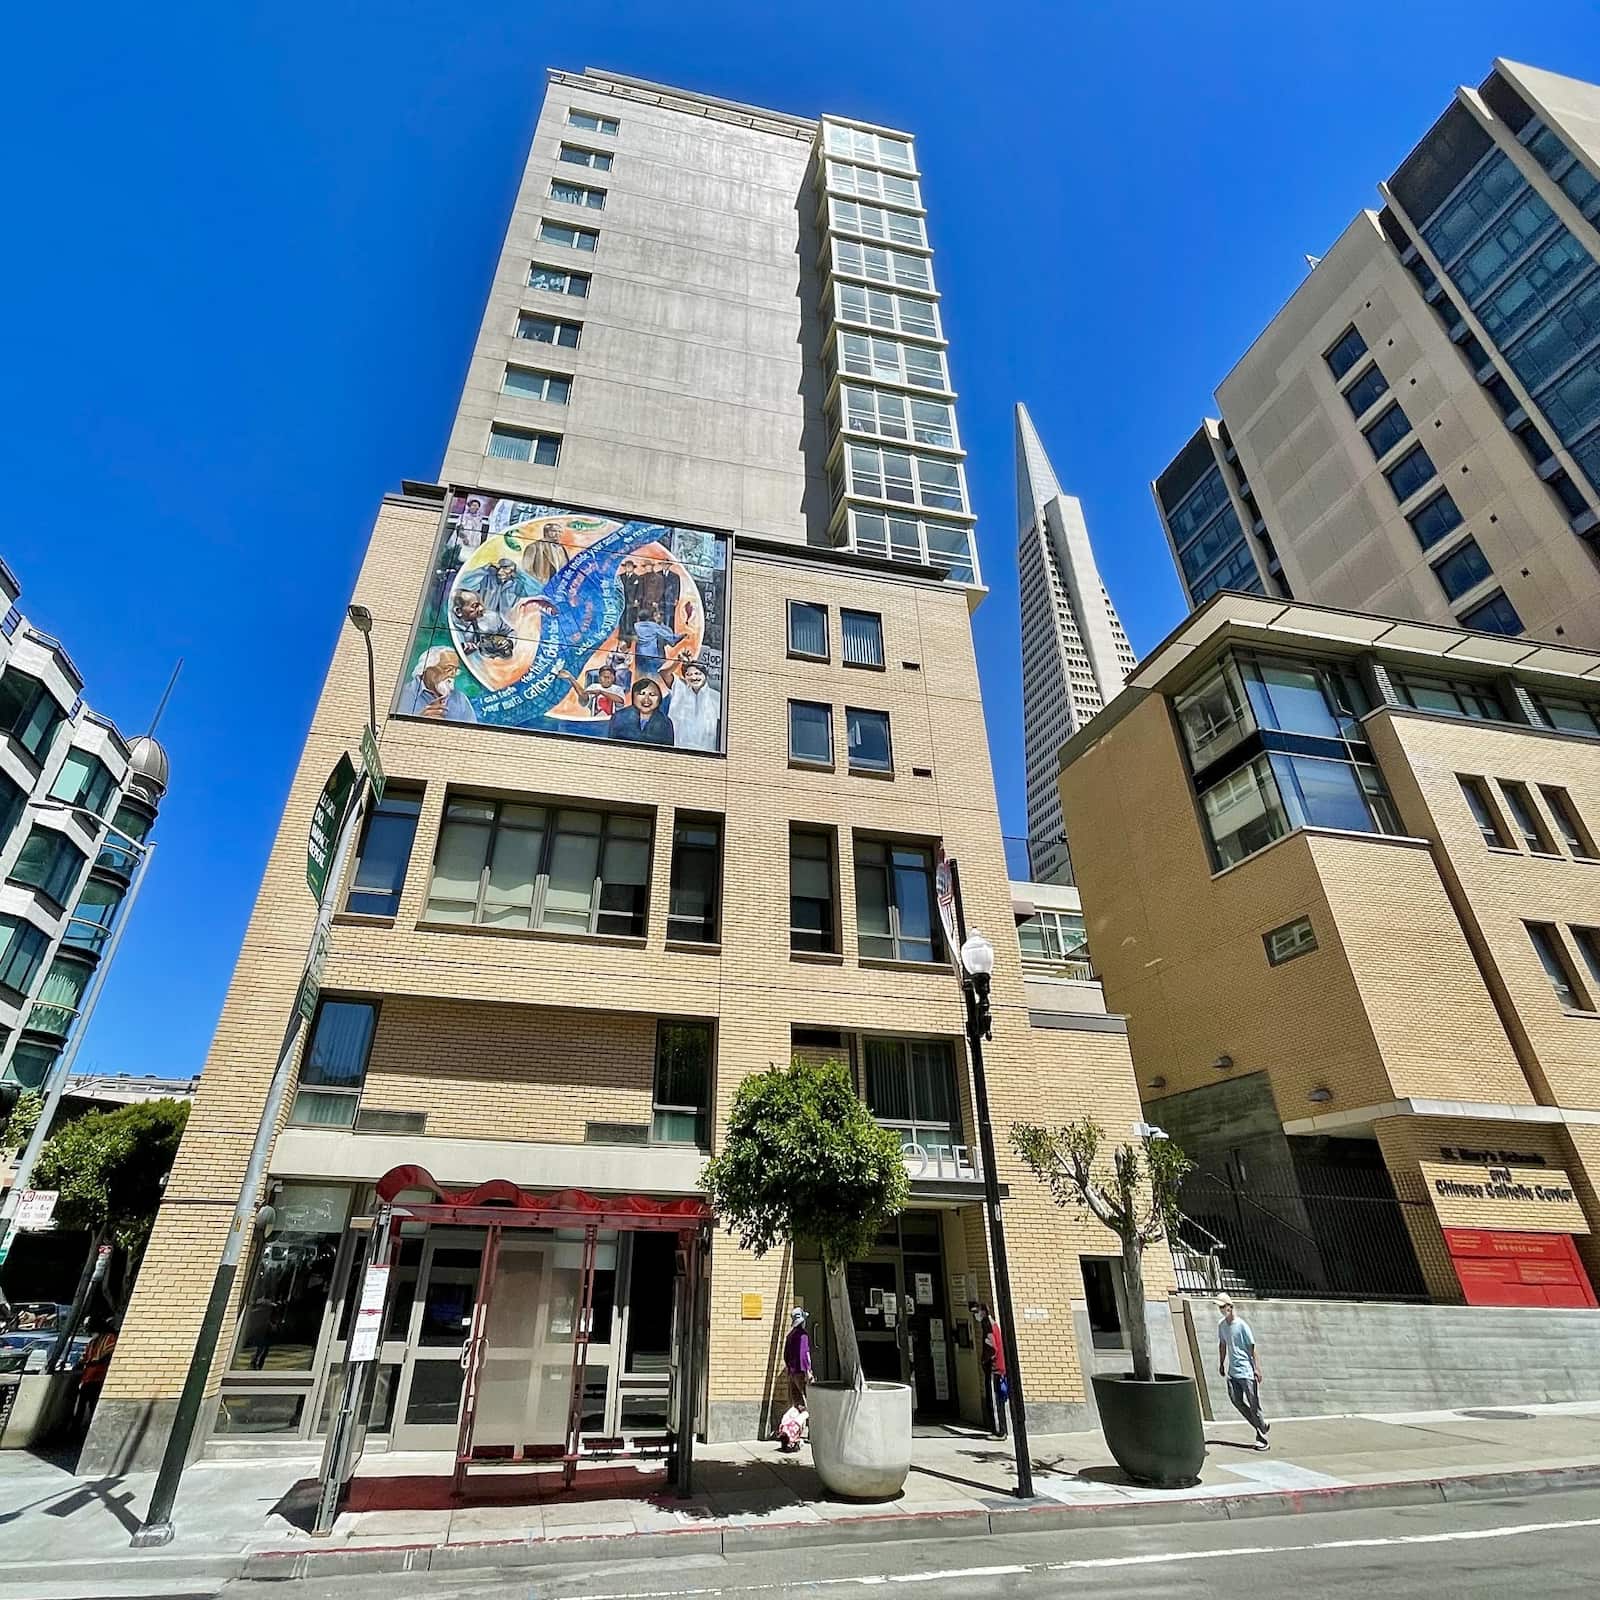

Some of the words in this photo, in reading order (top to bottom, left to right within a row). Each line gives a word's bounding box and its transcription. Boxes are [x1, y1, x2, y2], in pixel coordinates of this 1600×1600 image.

[520, 671, 536, 683] the
[529, 654, 552, 674] thick
[1435, 1180, 1483, 1198] Chinese
[1535, 1184, 1573, 1202] Center
